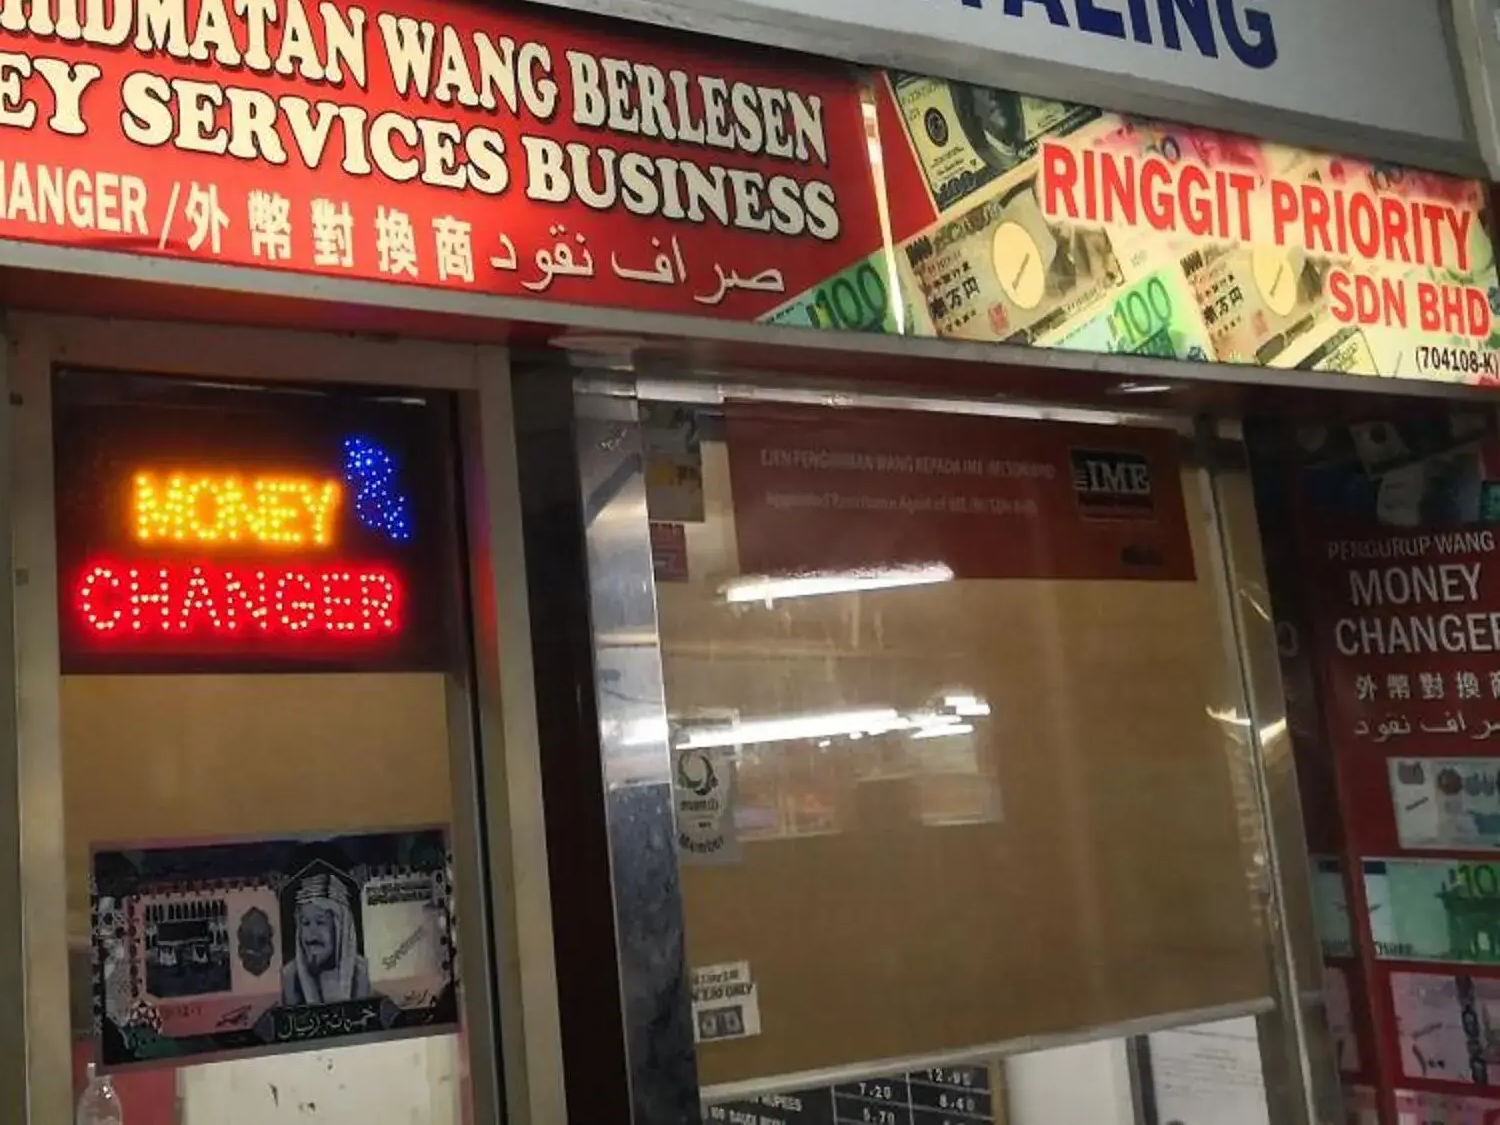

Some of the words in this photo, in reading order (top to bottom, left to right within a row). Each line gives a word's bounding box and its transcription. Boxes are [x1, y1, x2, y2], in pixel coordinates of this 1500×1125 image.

[378, 12, 556, 118] WANG
[565, 49, 829, 165] BERLESEN
[121, 70, 509, 192] SERVICES
[525, 135, 840, 241] BUSINESS
[1040, 141, 1260, 244] RINGGIT
[1270, 182, 1472, 272] PRIORITY
[1329, 270, 1407, 331] SDN
[1417, 282, 1490, 338] BHD
[1415, 346, 1499, 379] (704108-K)
[134, 472, 340, 544] MONEY
[1085, 460, 1152, 496] IME
[1327, 537, 1431, 561] PENGURUP
[1435, 531, 1495, 556] WANG
[80, 566, 396, 632] CHANGER
[1348, 562, 1482, 607] MONEY
